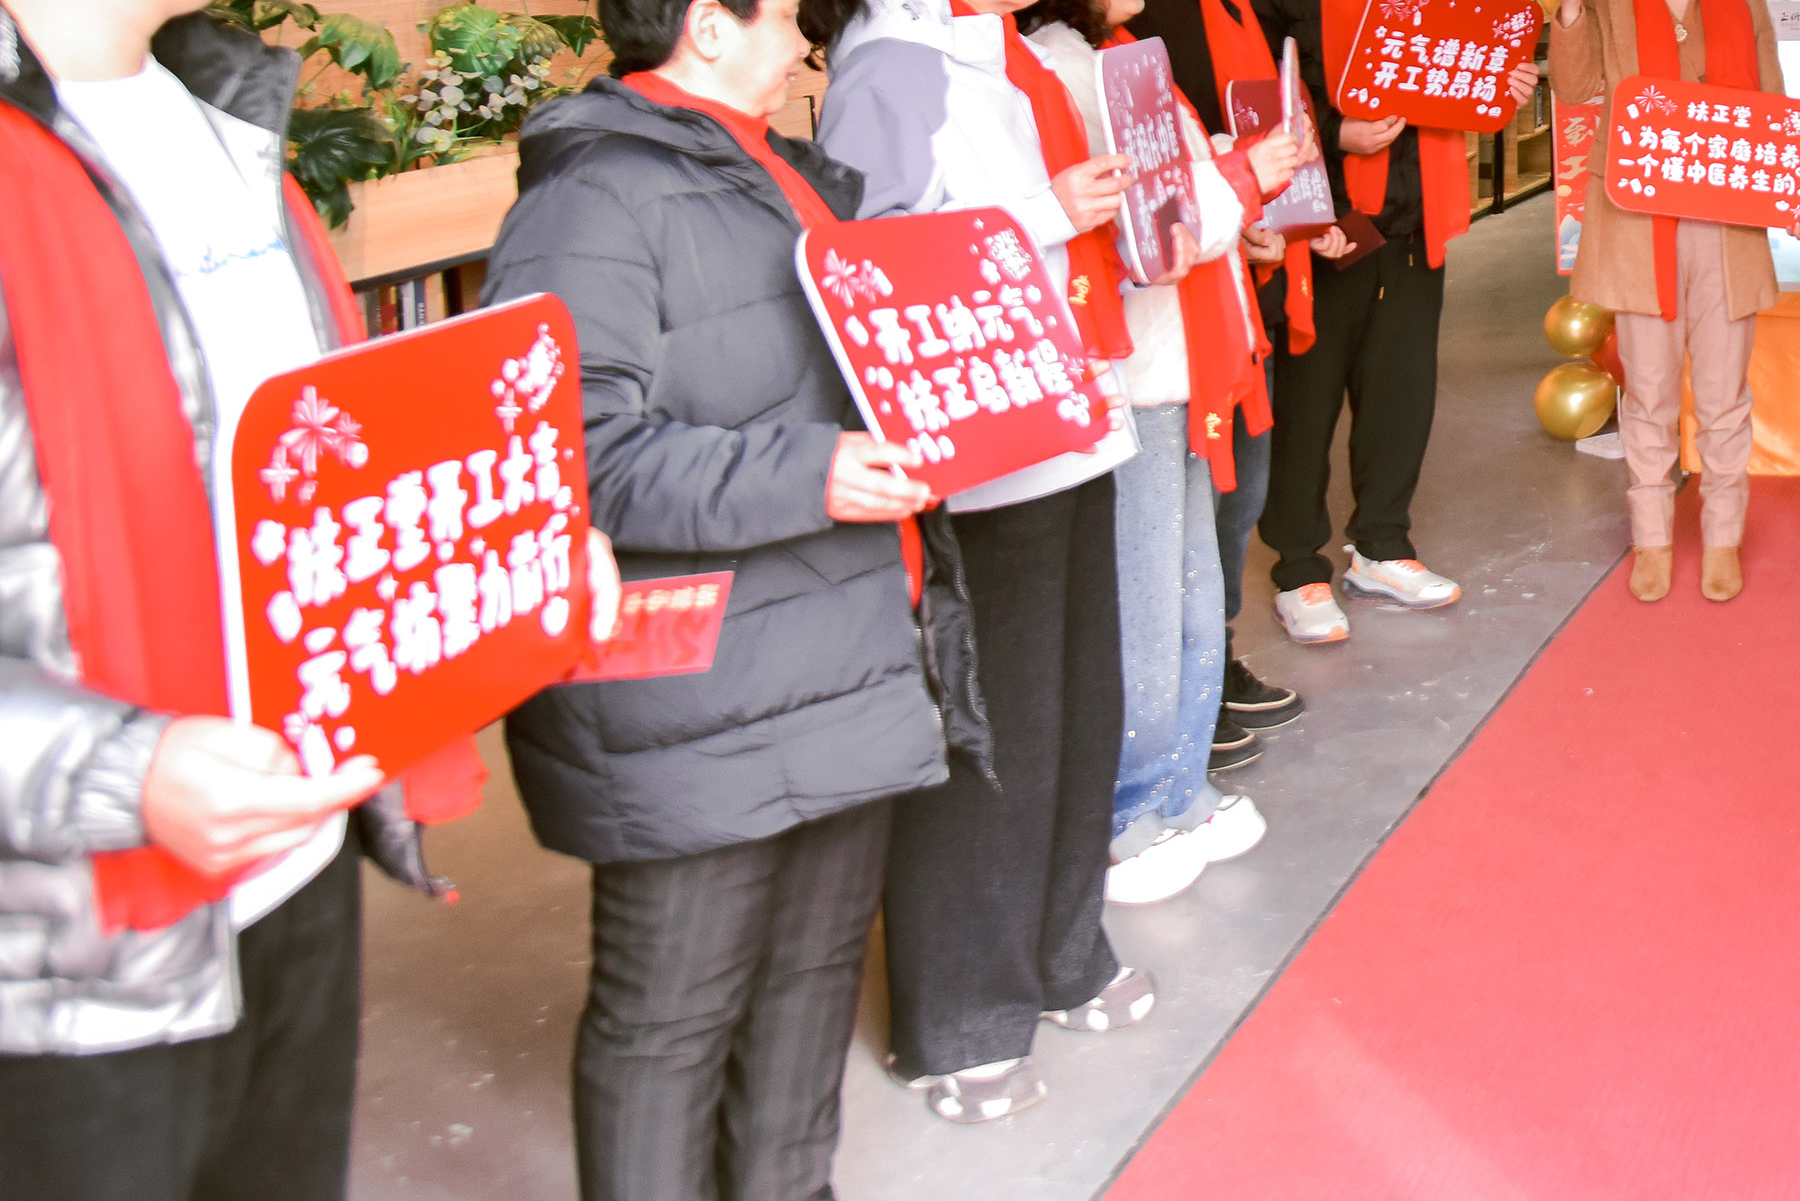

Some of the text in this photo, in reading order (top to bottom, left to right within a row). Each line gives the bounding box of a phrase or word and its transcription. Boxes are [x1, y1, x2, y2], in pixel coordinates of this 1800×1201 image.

[1380, 31, 1508, 73] 元气谱新章
[1373, 61, 1498, 102] 开工势昂扬
[1687, 101, 1752, 128] 扶正堂
[1639, 125, 1800, 169] 为每个家庭培养
[287, 420, 560, 606] 扶正堂开工大吉
